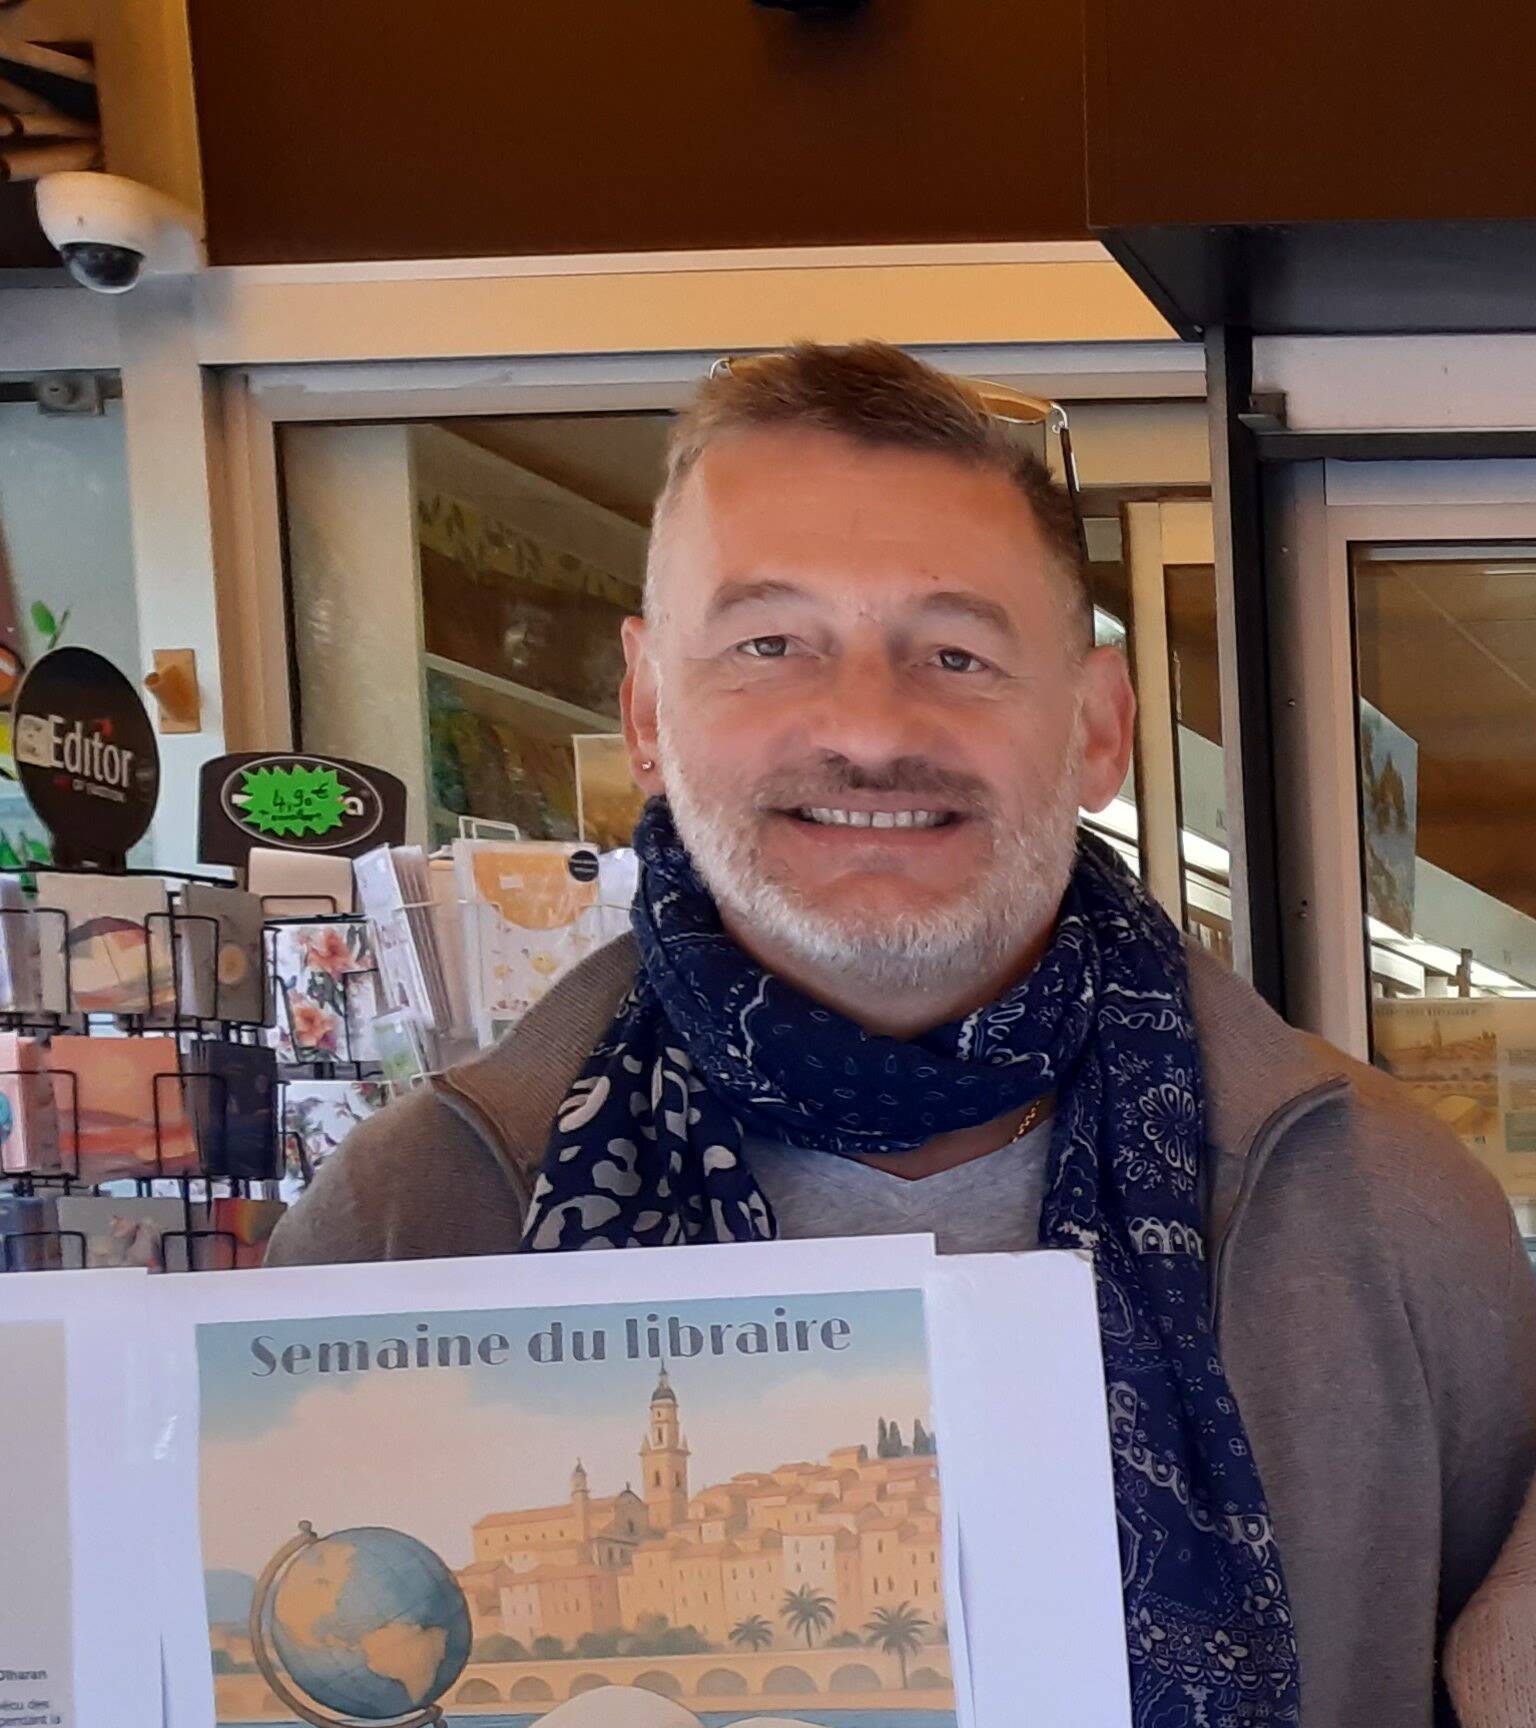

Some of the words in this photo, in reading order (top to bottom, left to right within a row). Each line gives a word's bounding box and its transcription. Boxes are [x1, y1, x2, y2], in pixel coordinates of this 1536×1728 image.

[48, 715, 135, 790] Editor
[250, 1325, 511, 1378] Semaine
[527, 1320, 608, 1367] du
[625, 1309, 852, 1361] libraire
